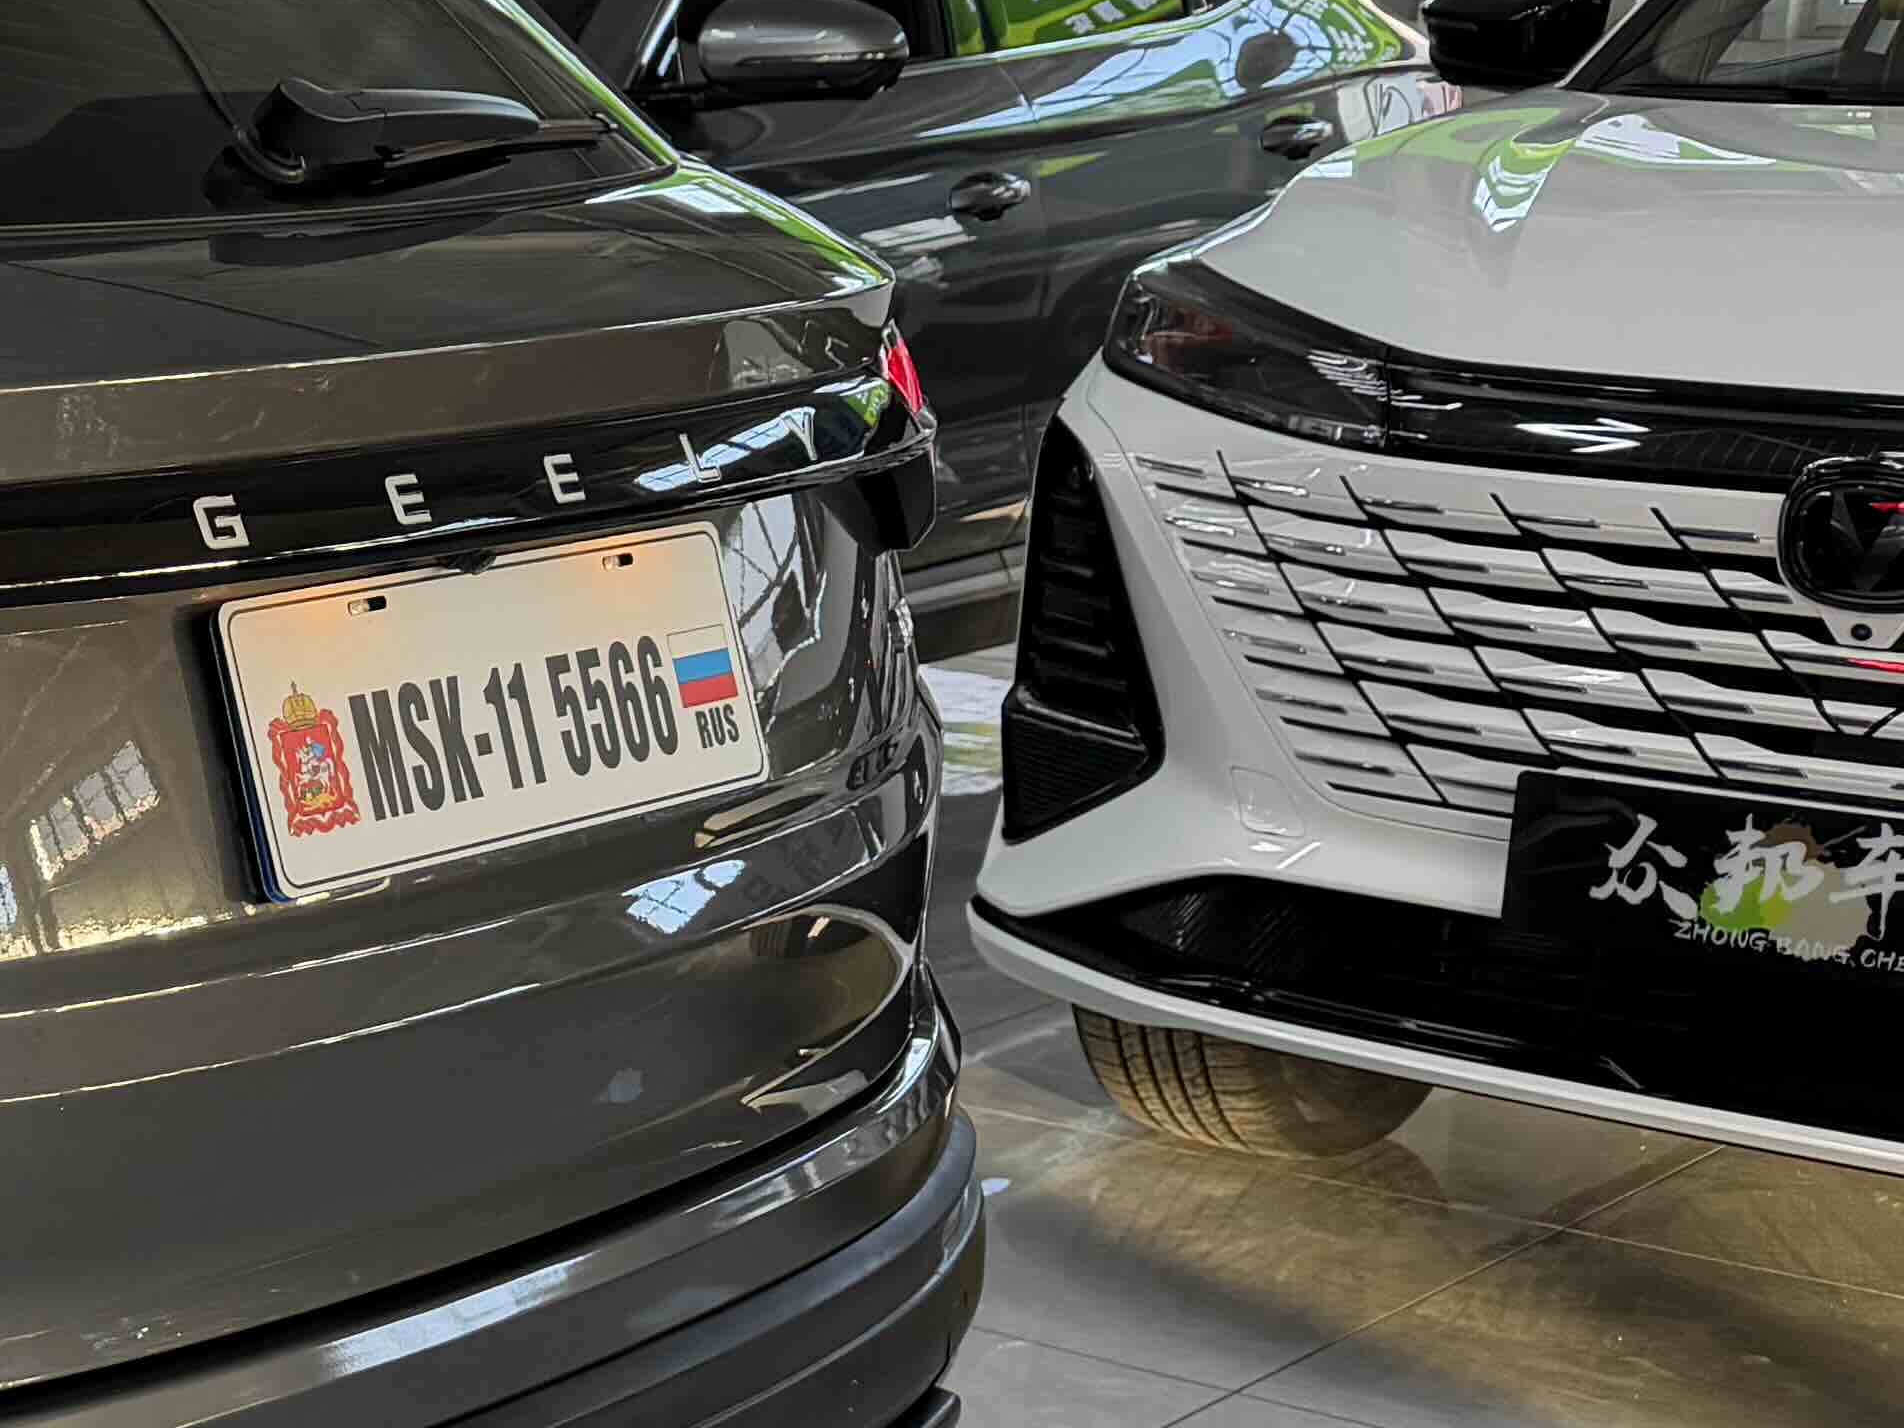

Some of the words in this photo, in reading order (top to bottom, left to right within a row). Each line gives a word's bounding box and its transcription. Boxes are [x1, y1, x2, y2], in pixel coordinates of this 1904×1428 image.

[192, 405, 820, 550] GEELY
[347, 661, 547, 822] MSK-11
[544, 635, 679, 777] 5566
[695, 703, 740, 749] RUS
